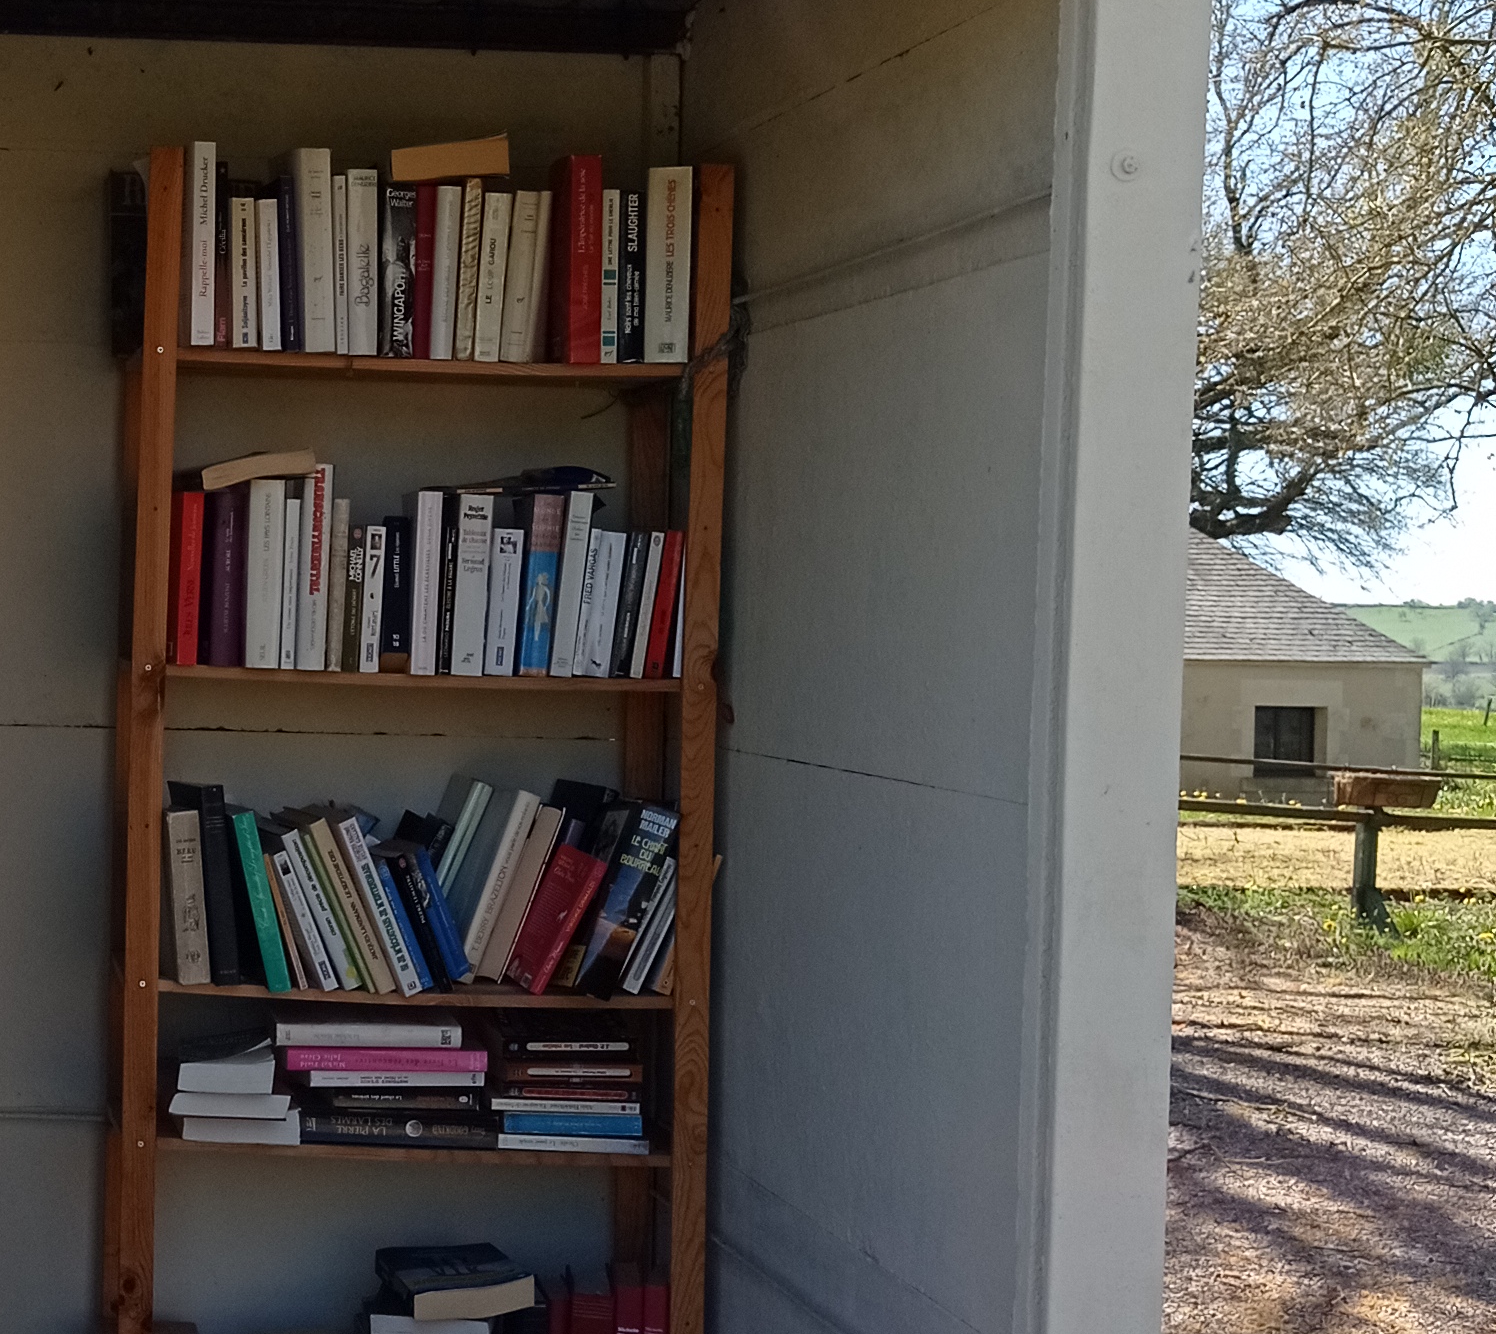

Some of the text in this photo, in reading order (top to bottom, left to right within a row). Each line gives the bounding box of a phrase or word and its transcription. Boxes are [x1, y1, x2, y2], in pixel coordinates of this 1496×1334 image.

[200, 157, 208, 192] Drucker
[387, 188, 416, 199] Georges
[390, 198, 413, 207] Walter
[628, 194, 639, 252] SLAUGHTER
[666, 243, 674, 257] LES
[199, 240, 209, 297] Rappelle-moi
[354, 244, 374, 306] Bagatelle
[485, 295, 492, 304] LE
[665, 295, 673, 322] MAURICE
[468, 505, 484, 513] Roger
[355, 547, 363, 582] CONNELLY
[583, 548, 598, 604] FRED VARGAS
[641, 810, 677, 830] NORMAN
[639, 820, 670, 838] MAILER
[631, 834, 641, 846] LE
[639, 849, 652, 861] DU
[310, 883, 317, 892] de
[344, 889, 352, 899] LE
[474, 916, 489, 944] BERRY
[484, 864, 508, 914] BRAZELTON
[377, 907, 388, 917] JE
[414, 903, 426, 923] PIERRE
[324, 916, 336, 936] cioran
[362, 933, 378, 961] JACQUES
[395, 953, 406, 964] JE
[324, 1053, 340, 1061] Julie
[330, 1116, 392, 1126] DES LARMES
[336, 1125, 386, 1135] LA PIERRE
